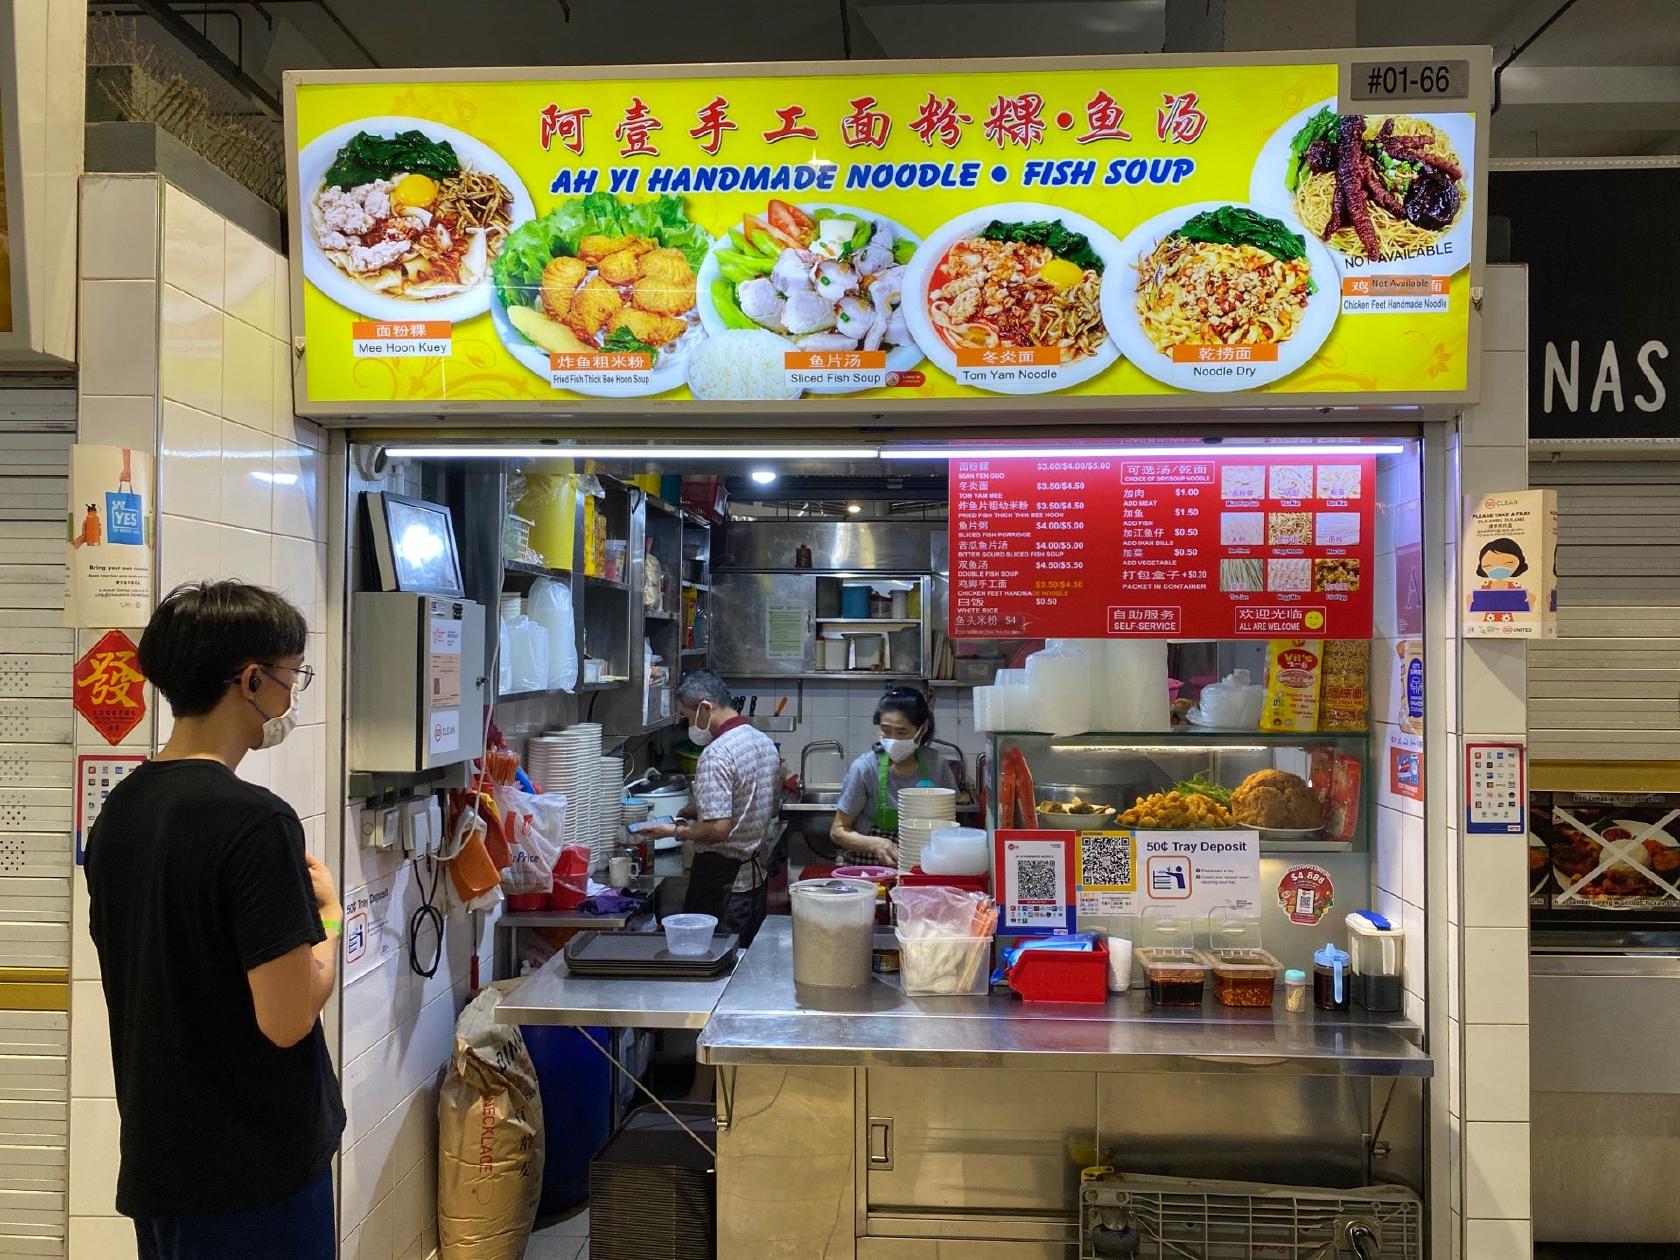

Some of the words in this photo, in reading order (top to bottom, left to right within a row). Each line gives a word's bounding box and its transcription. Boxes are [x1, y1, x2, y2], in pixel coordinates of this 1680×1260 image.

[1368, 67, 1449, 93] #01-66
[552, 169, 597, 195] AH
[609, 168, 638, 194] YI
[647, 166, 837, 194] HANDMADE
[846, 161, 982, 191] NOODLE
[1024, 159, 1099, 186] FISH
[1105, 157, 1196, 186] SOUP
[1378, 242, 1453, 263] AVAILABLE
[1372, 279, 1387, 287] Not
[1390, 279, 1429, 288] Available
[1344, 300, 1369, 310] Chicken
[1371, 300, 1386, 309] Feet
[1387, 299, 1423, 309] Handmade
[1424, 299, 1447, 308] Noodle
[376, 323, 428, 338] 面粉粿
[359, 343, 383, 353] Mee
[386, 343, 416, 353] Hoon
[419, 343, 448, 356] Kuey
[1199, 346, 1252, 362] 乾捞面
[810, 353, 862, 369] 鱼片汤
[983, 350, 1035, 365] 冬炎面
[963, 370, 987, 381] Tom
[990, 370, 1015, 381] Yam
[1019, 369, 1057, 380] Noodle
[1194, 366, 1232, 378] Noodle
[1234, 367, 1256, 379] Dry
[1544, 340, 1668, 414] NAS
[554, 374, 569, 385] Fried
[570, 374, 584, 385] Fish
[585, 374, 601, 385] Thick
[603, 374, 614, 385] Bee
[616, 374, 635, 385] Hoon
[637, 374, 651, 385] Soup
[791, 373, 822, 384] Sliced
[824, 373, 844, 384] Fish
[849, 372, 881, 386] Soup
[1037, 482, 1085, 490] $3.50/$4.50
[1123, 489, 1144, 498] 加肉
[1175, 488, 1199, 496] $1.00
[112, 500, 126, 509] SAY
[1036, 502, 1085, 510] $3.50/$4.50
[1123, 508, 1144, 518] 加鱼
[1174, 508, 1199, 516] $1.50
[115, 511, 137, 528] YES
[1036, 522, 1084, 530] $4.00/$5.00
[1123, 528, 1165, 538] 加江鱼仔
[1174, 528, 1198, 536] $0.50
[1123, 549, 1143, 558] 加菜
[1174, 548, 1198, 557] $0.50
[89, 564, 106, 572] Bring
[1036, 561, 1083, 569] $4.50/$5.50
[1122, 570, 1181, 580] 打包盒子
[958, 598, 985, 607] 白饭
[1113, 609, 1175, 620] 自助服务
[1239, 609, 1303, 619] 欢迎光临
[956, 615, 998, 626] 鱼头米粉
[1005, 616, 1017, 625] $4
[1113, 622, 1176, 630] SELF-SERVICE
[1239, 622, 1252, 631] ALL
[1253, 622, 1266, 631] ARE
[1268, 622, 1301, 631] WELCOME
[1284, 653, 1313, 663] Vit's
[1146, 840, 1168, 852] 50¢
[1172, 841, 1197, 854] Tray
[1200, 840, 1247, 854] Deposit
[358, 899, 369, 910] Tray
[369, 888, 389, 904] Deposit
[479, 1095, 498, 1174] NECKLACE
